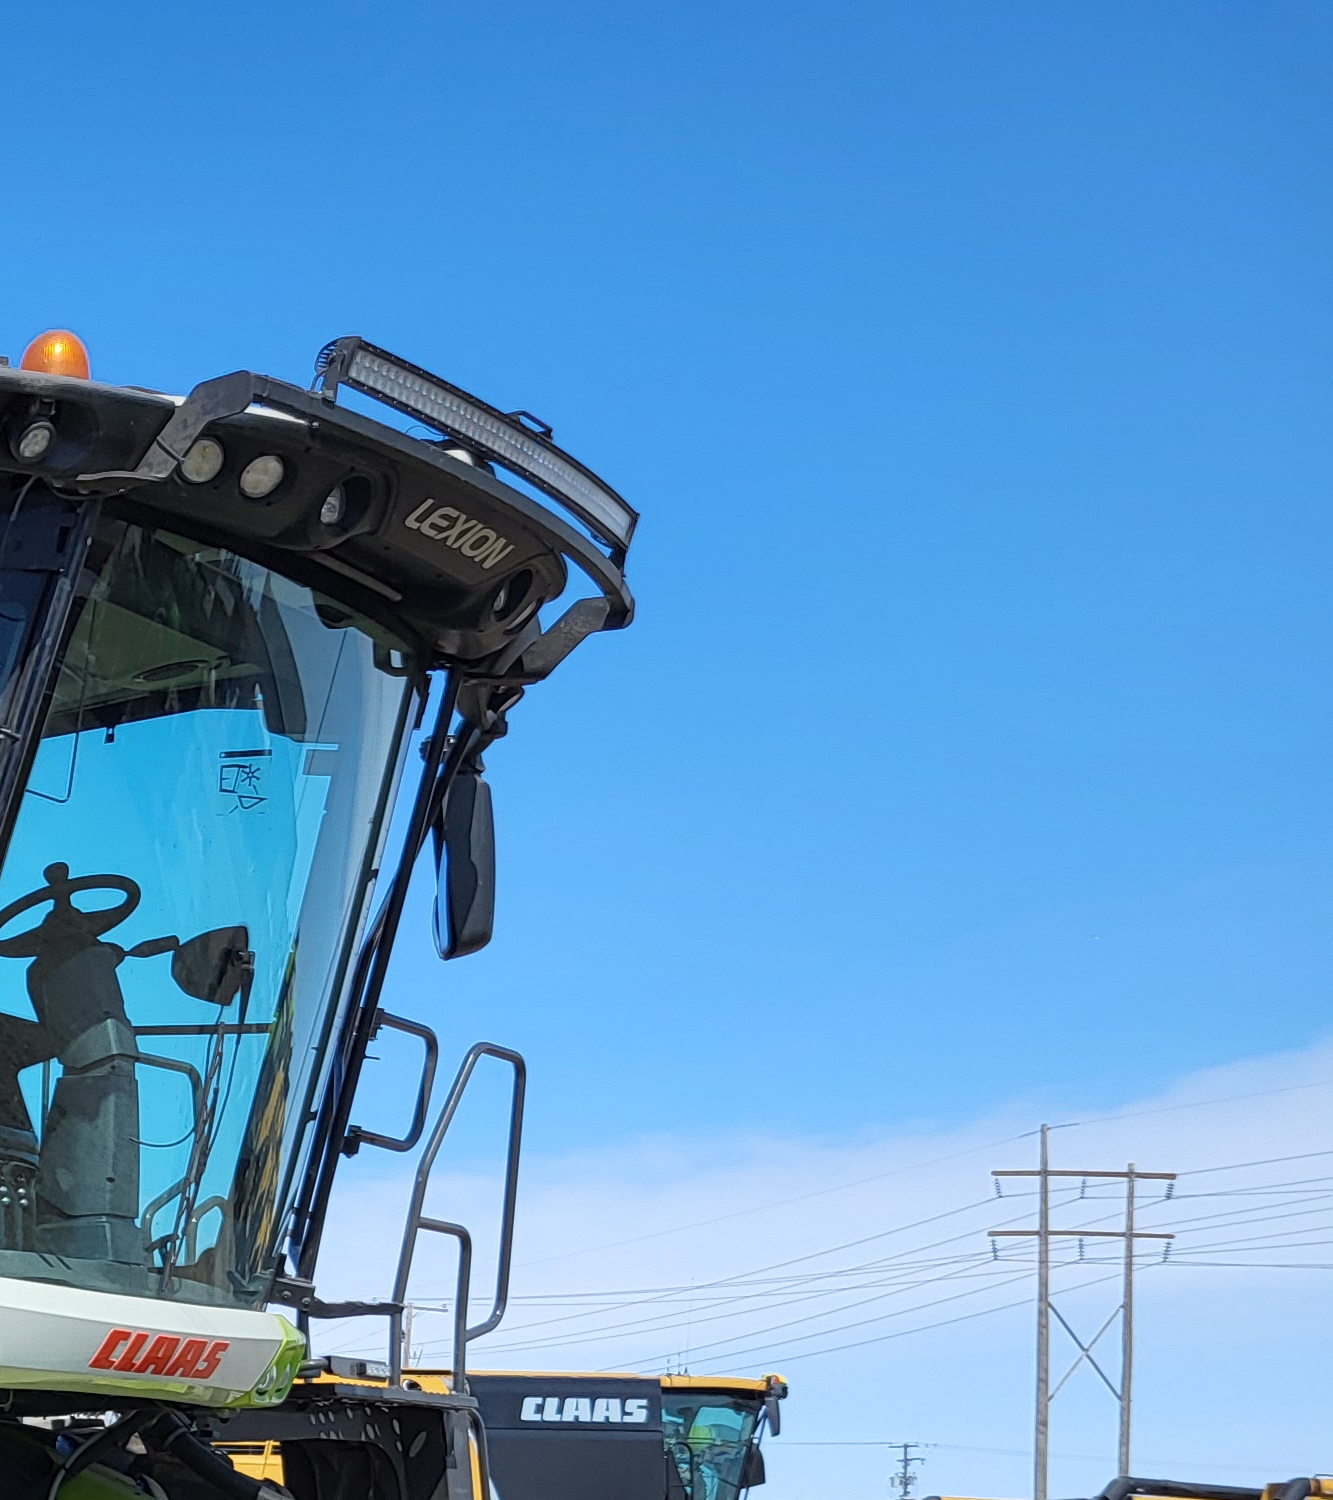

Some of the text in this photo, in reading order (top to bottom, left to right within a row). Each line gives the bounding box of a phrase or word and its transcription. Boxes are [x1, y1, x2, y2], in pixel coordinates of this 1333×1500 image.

[404, 498, 515, 570] LEXION
[88, 1328, 231, 1380] CLAAS
[520, 1396, 649, 1424] CLAAS
